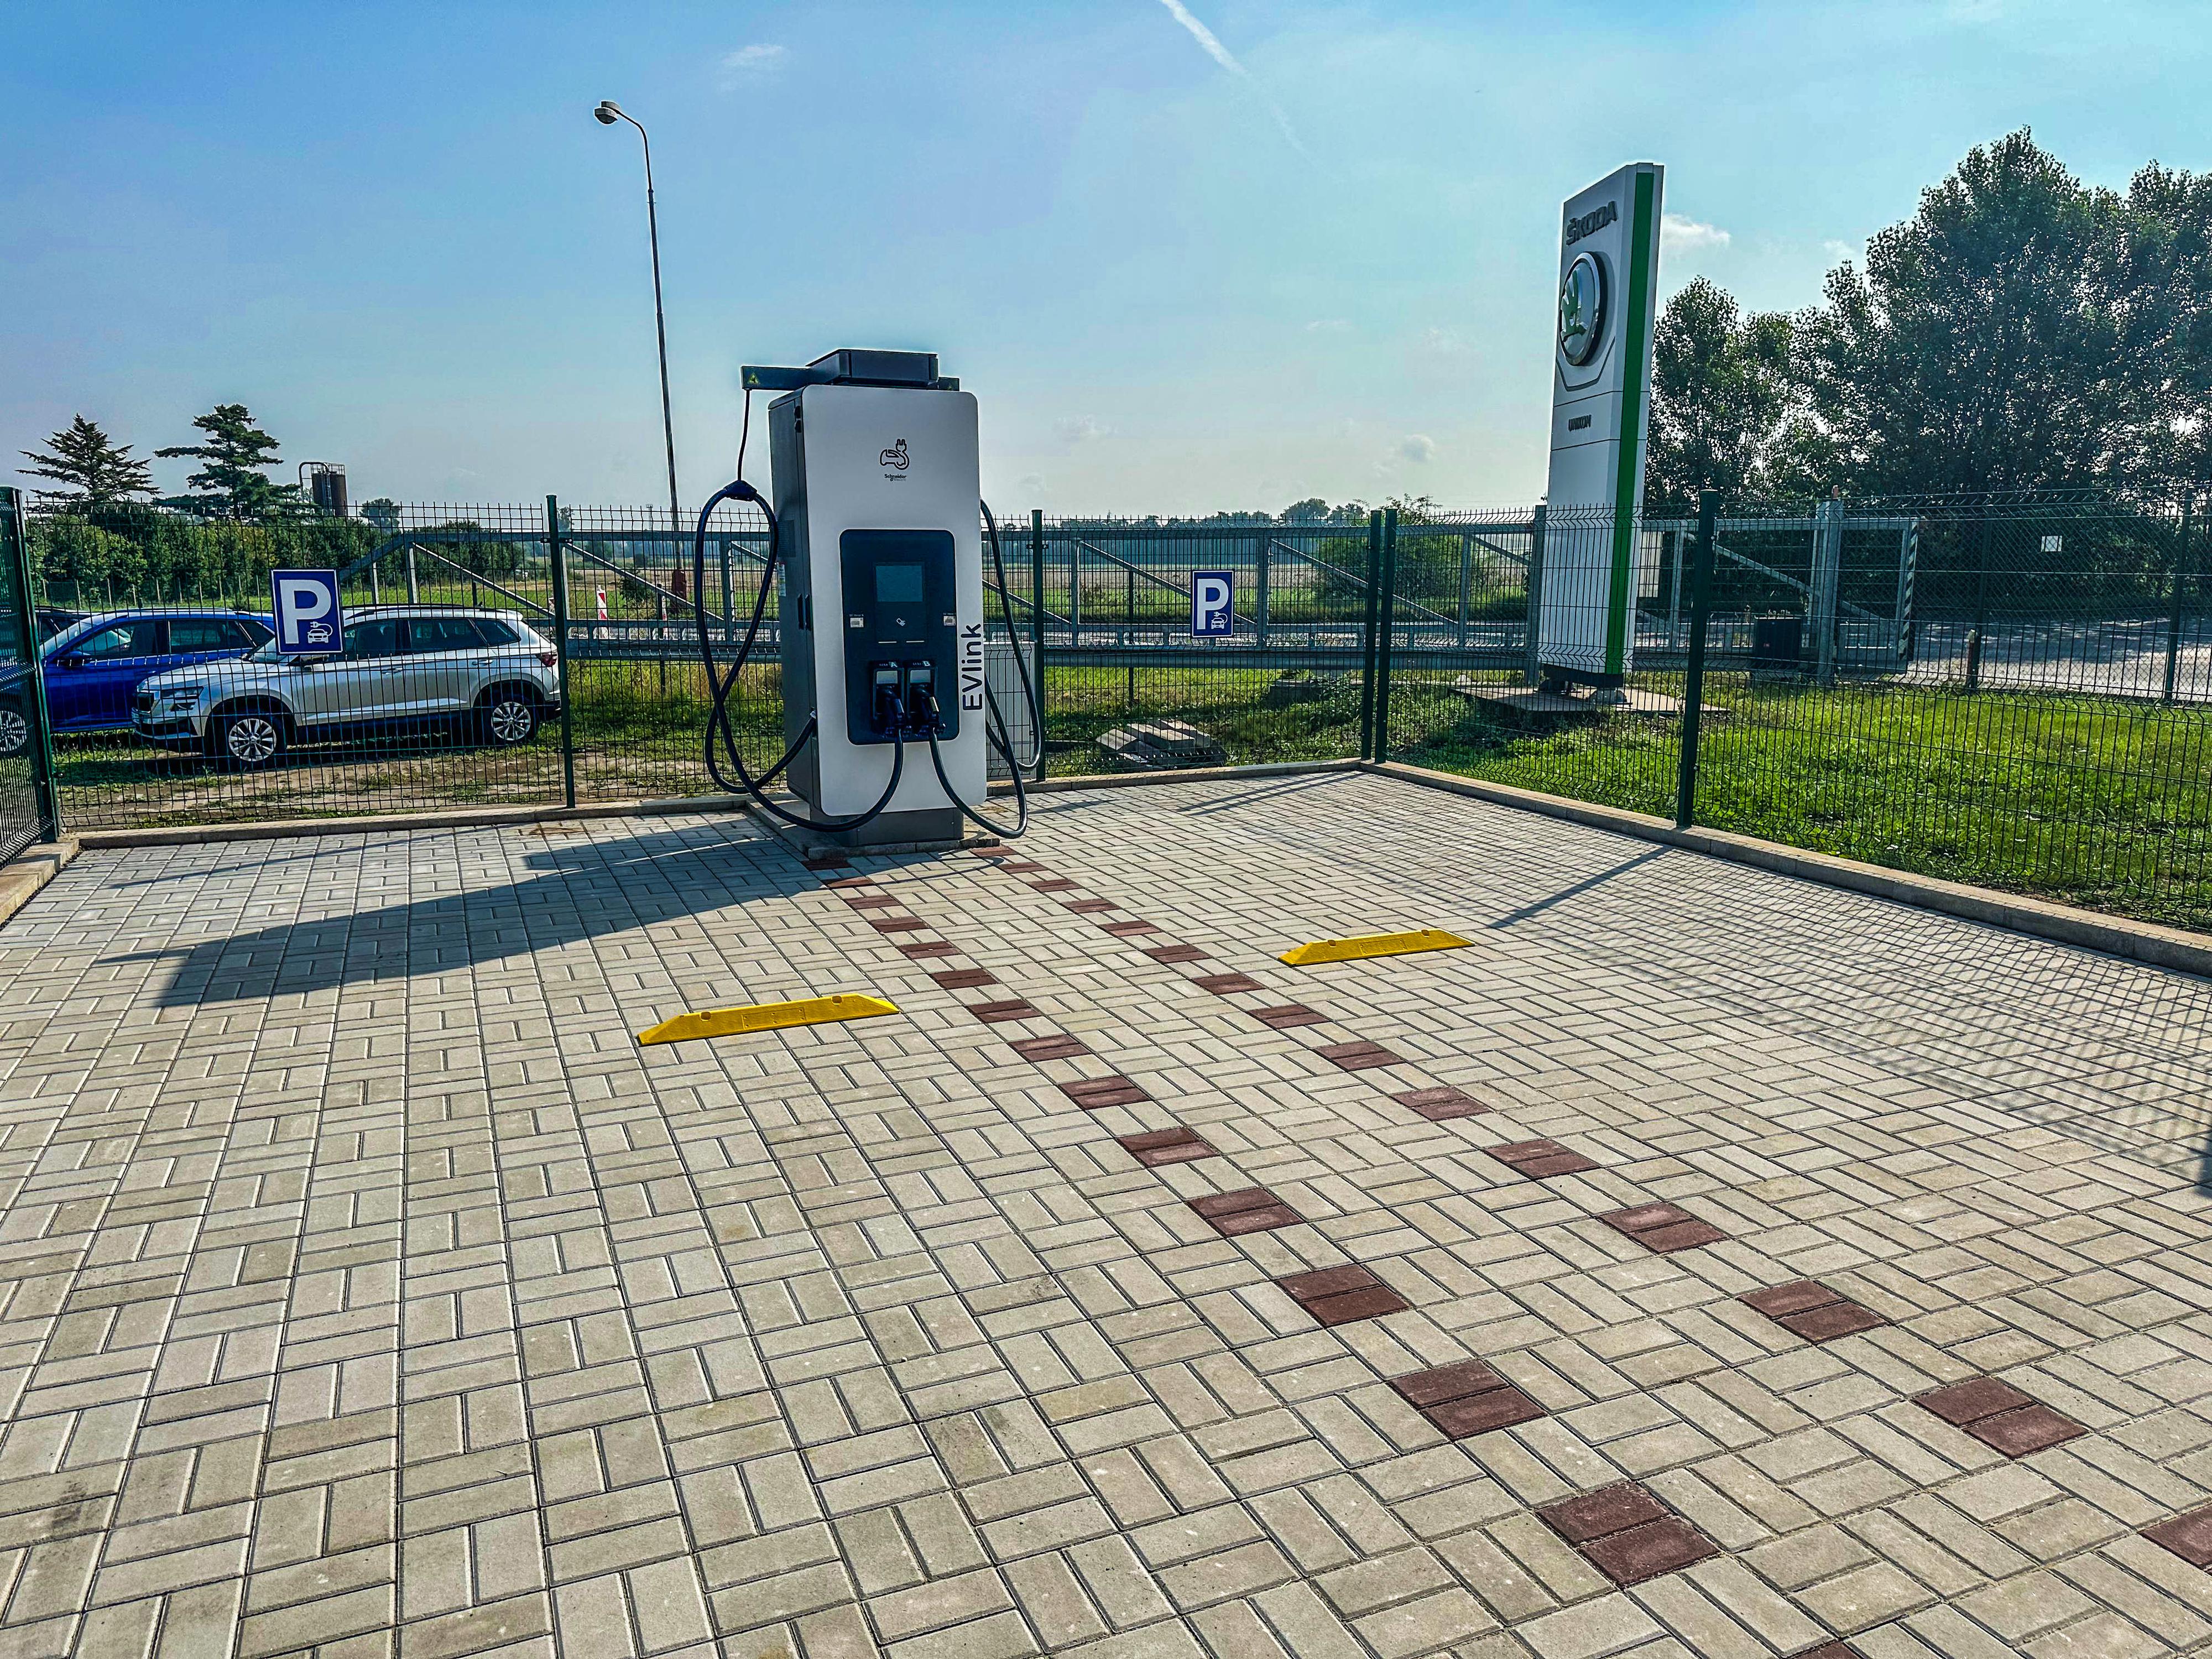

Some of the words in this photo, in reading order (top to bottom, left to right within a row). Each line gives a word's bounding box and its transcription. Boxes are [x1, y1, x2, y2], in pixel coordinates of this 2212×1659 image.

[1566, 201, 1618, 246] ŠKODA
[279, 580, 331, 644] P
[1197, 578, 1229, 629] P
[961, 623, 983, 711] EVlink
